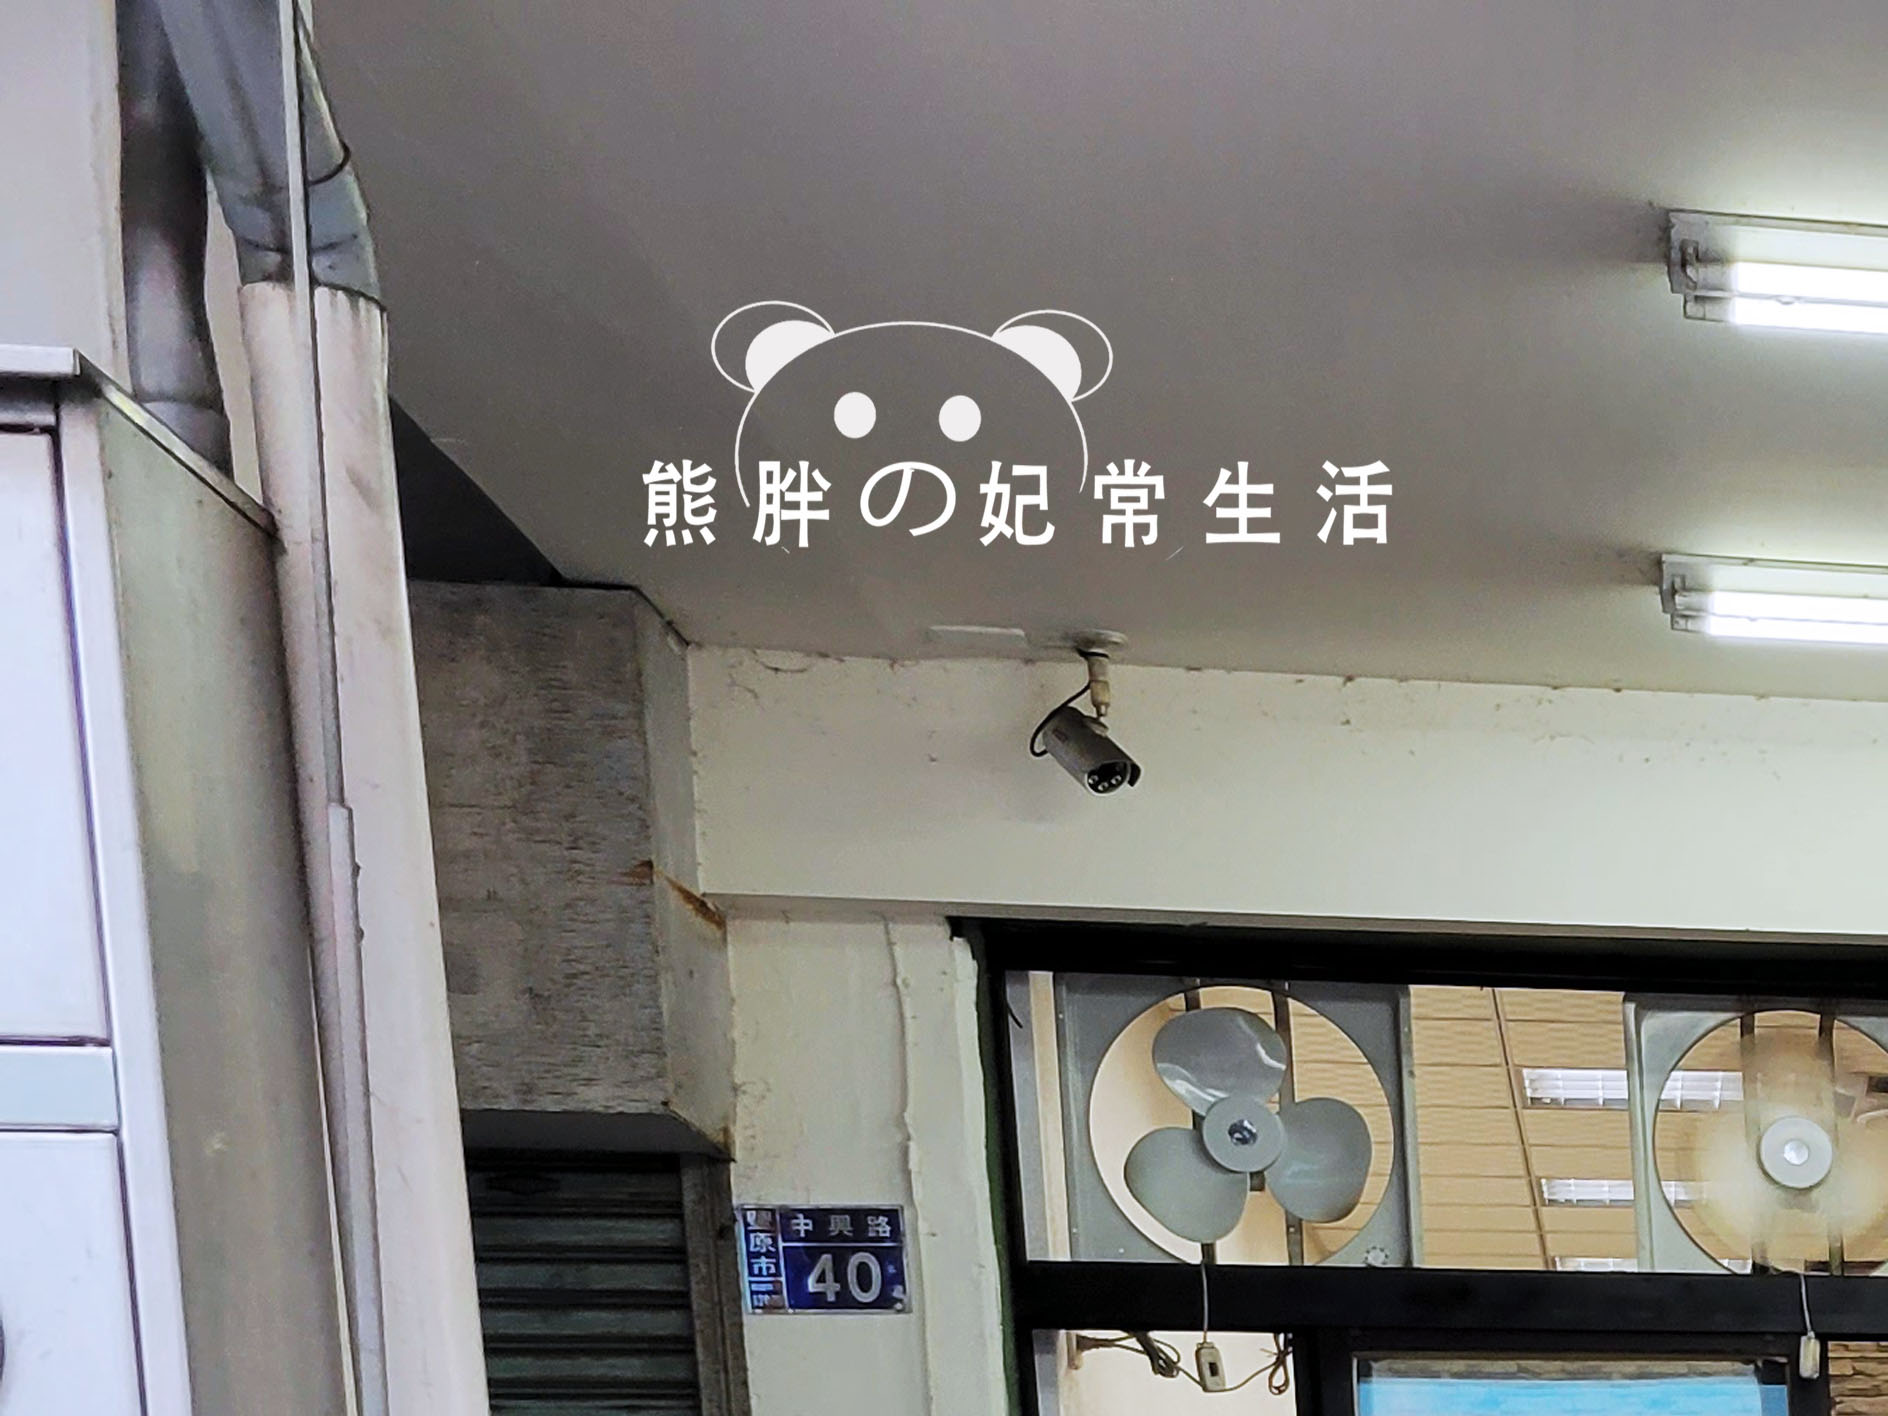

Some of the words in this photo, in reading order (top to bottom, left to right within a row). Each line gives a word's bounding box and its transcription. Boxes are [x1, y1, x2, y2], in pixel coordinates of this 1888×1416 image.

[791, 1213, 892, 1239] 中興路
[807, 1251, 882, 1304] 40
